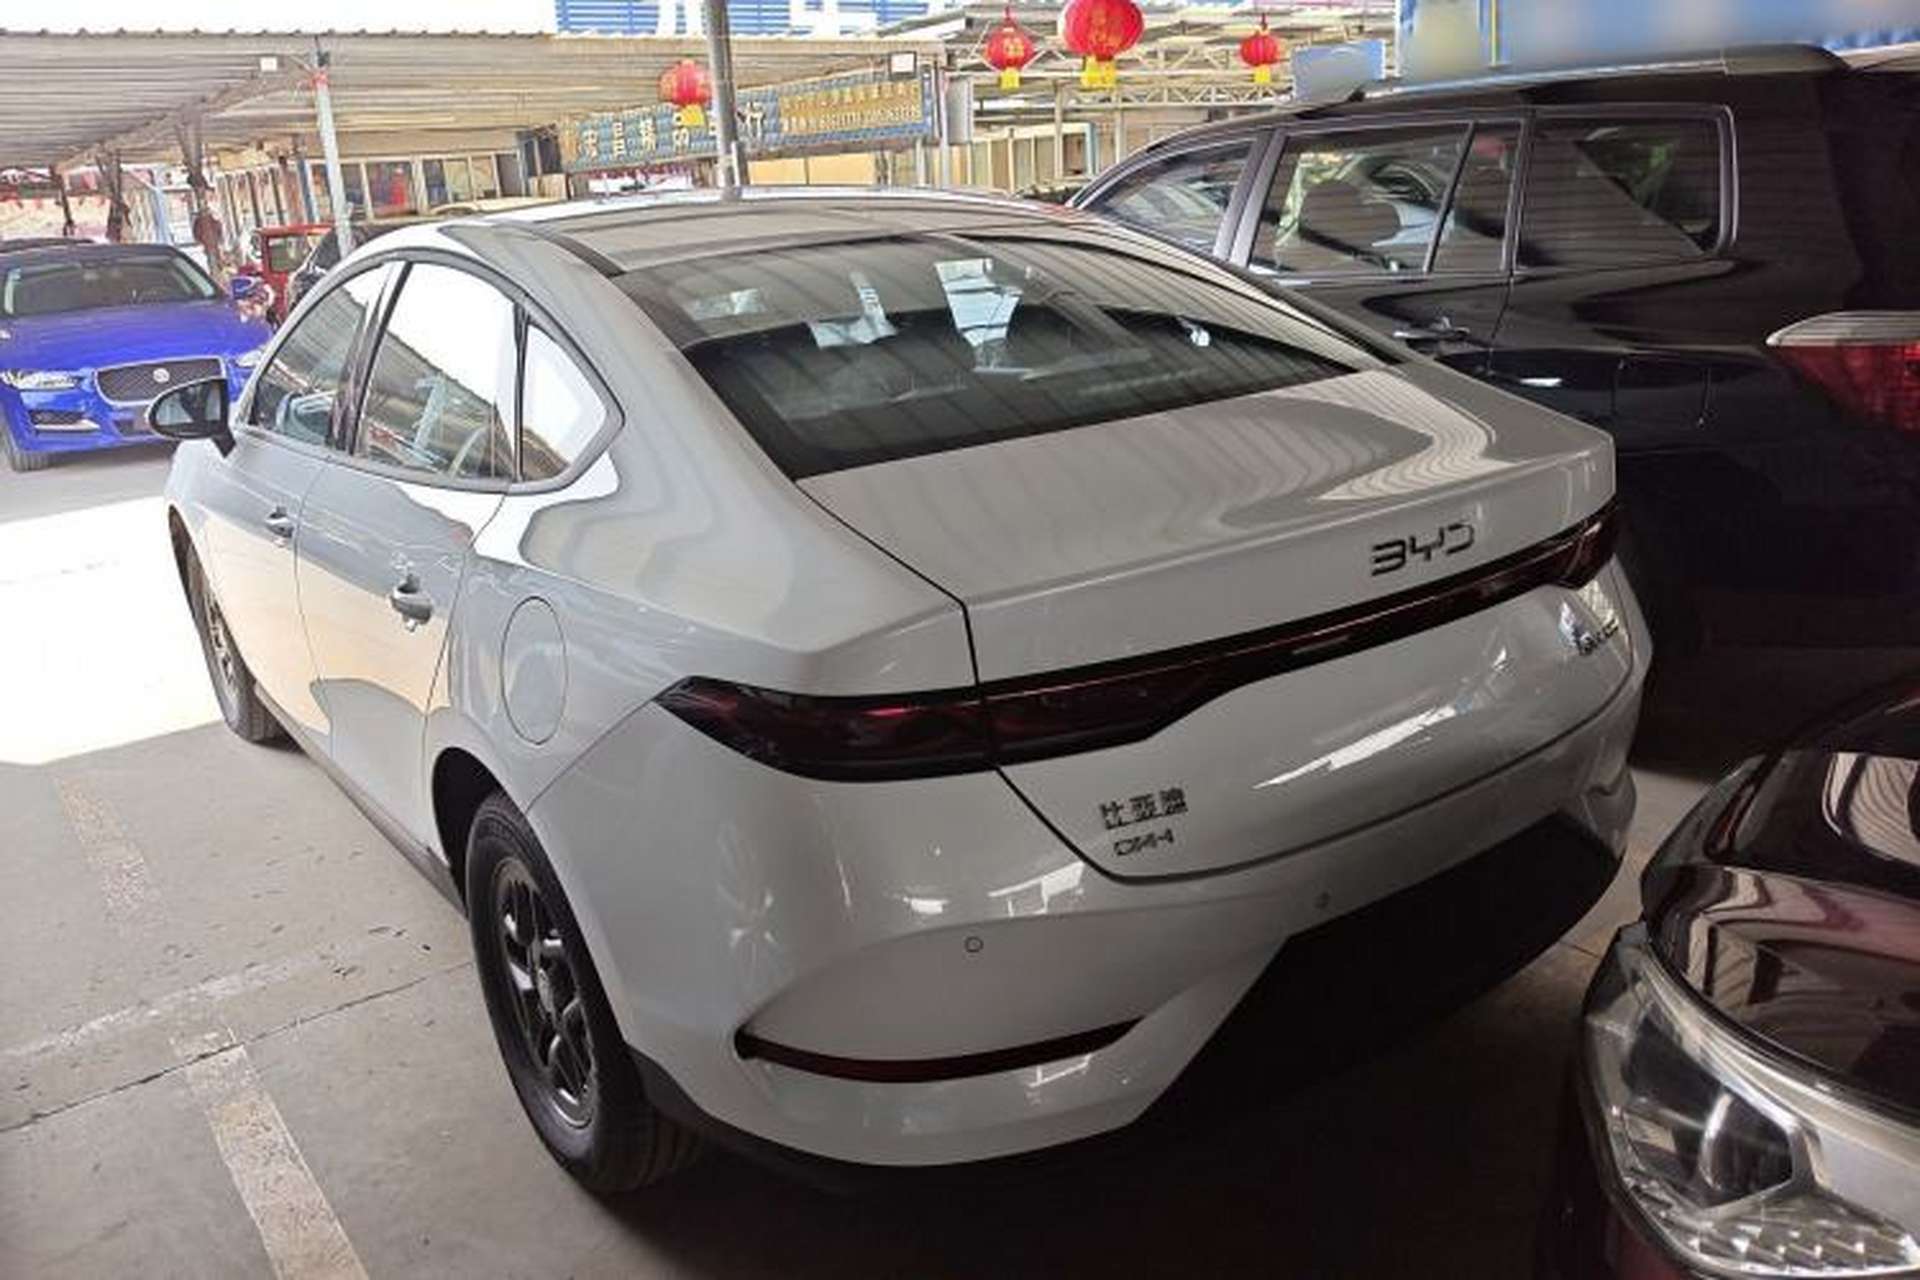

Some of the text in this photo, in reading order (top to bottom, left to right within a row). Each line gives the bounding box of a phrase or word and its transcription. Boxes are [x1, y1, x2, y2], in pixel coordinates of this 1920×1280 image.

[1371, 521, 1475, 577] BYD
[1100, 787, 1188, 830] 比亚迪
